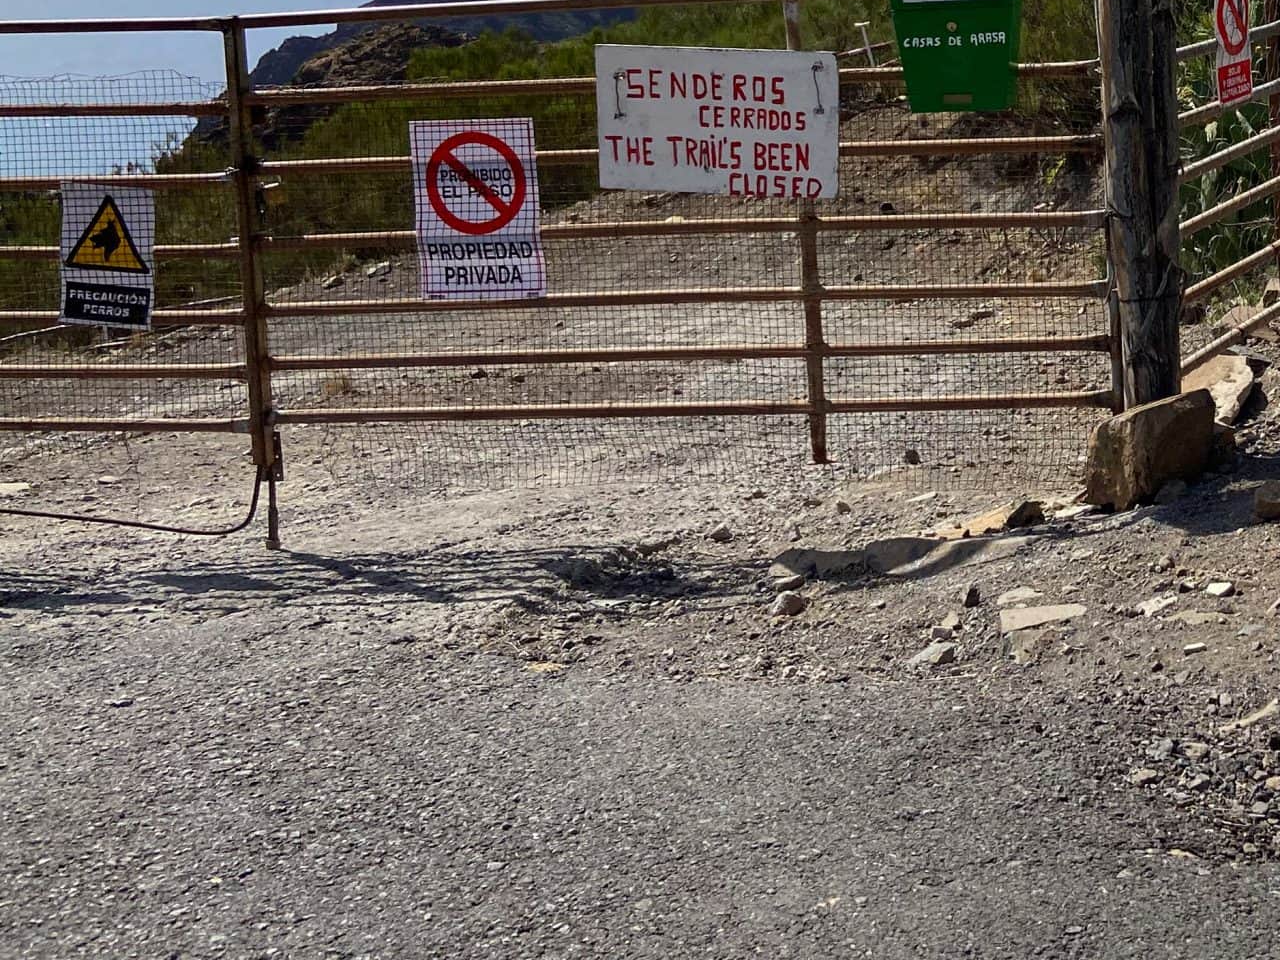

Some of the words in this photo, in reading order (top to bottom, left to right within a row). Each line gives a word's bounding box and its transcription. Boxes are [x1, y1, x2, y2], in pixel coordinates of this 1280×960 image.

[903, 36, 941, 48] CASAS
[948, 35, 962, 46] DE
[626, 68, 785, 105] SENDEROS
[699, 105, 807, 131] CERRADOS
[604, 135, 656, 167] THE
[754, 141, 811, 172] BEEN
[442, 185, 462, 198] EL
[467, 184, 513, 198] PSO
[729, 172, 823, 199] CLOSED
[427, 240, 533, 261] PROPIEDAD
[444, 264, 524, 286] PRIVADA
[69, 289, 147, 305] PRECAUCIÓN
[83, 303, 130, 317] PERROS
